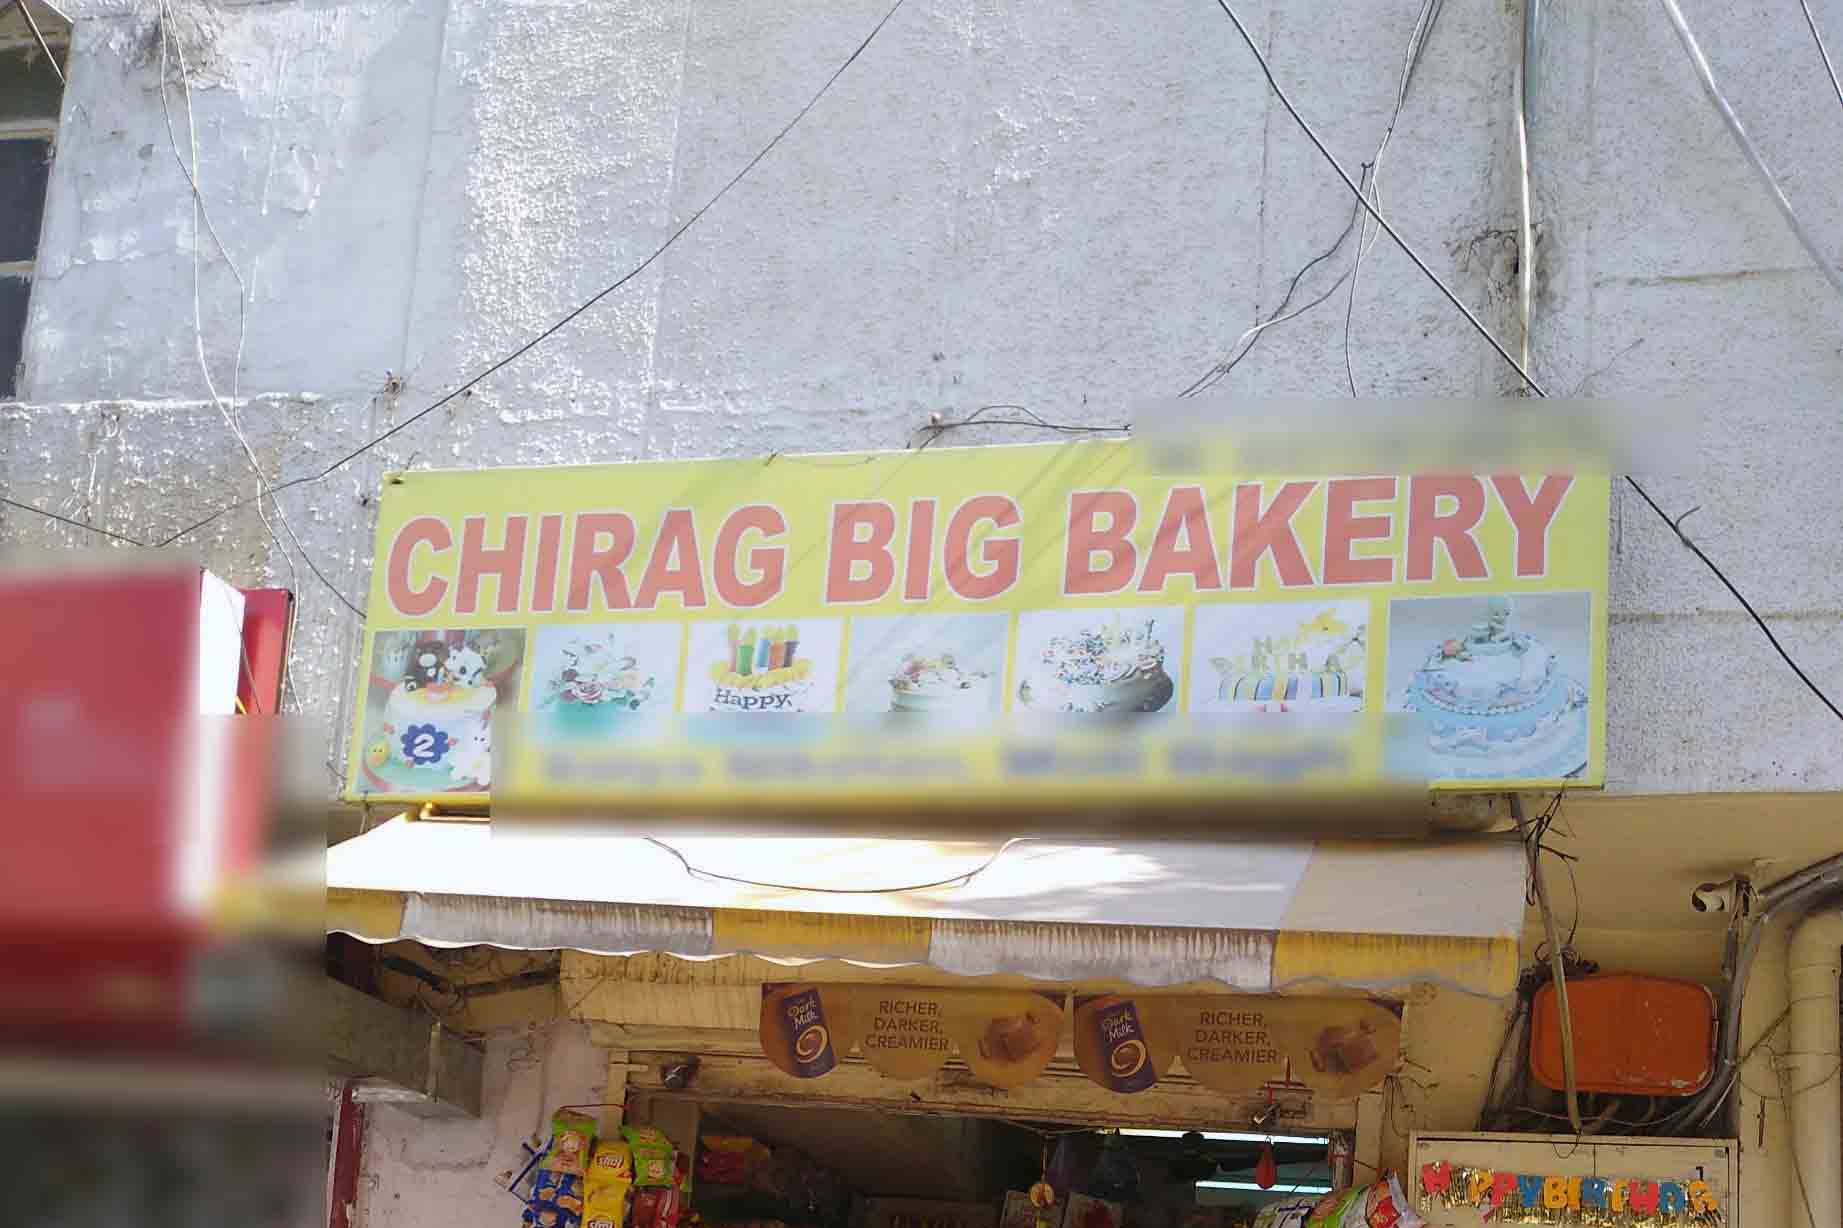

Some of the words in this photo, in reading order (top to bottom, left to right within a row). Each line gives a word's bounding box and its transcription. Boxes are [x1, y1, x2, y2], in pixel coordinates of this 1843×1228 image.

[386, 503, 787, 617] CHIRAG
[825, 494, 1021, 605] BIG
[1062, 473, 1575, 597] BAKERY
[413, 733, 435, 757] 2
[1422, 1159, 1543, 1208] HPPY
